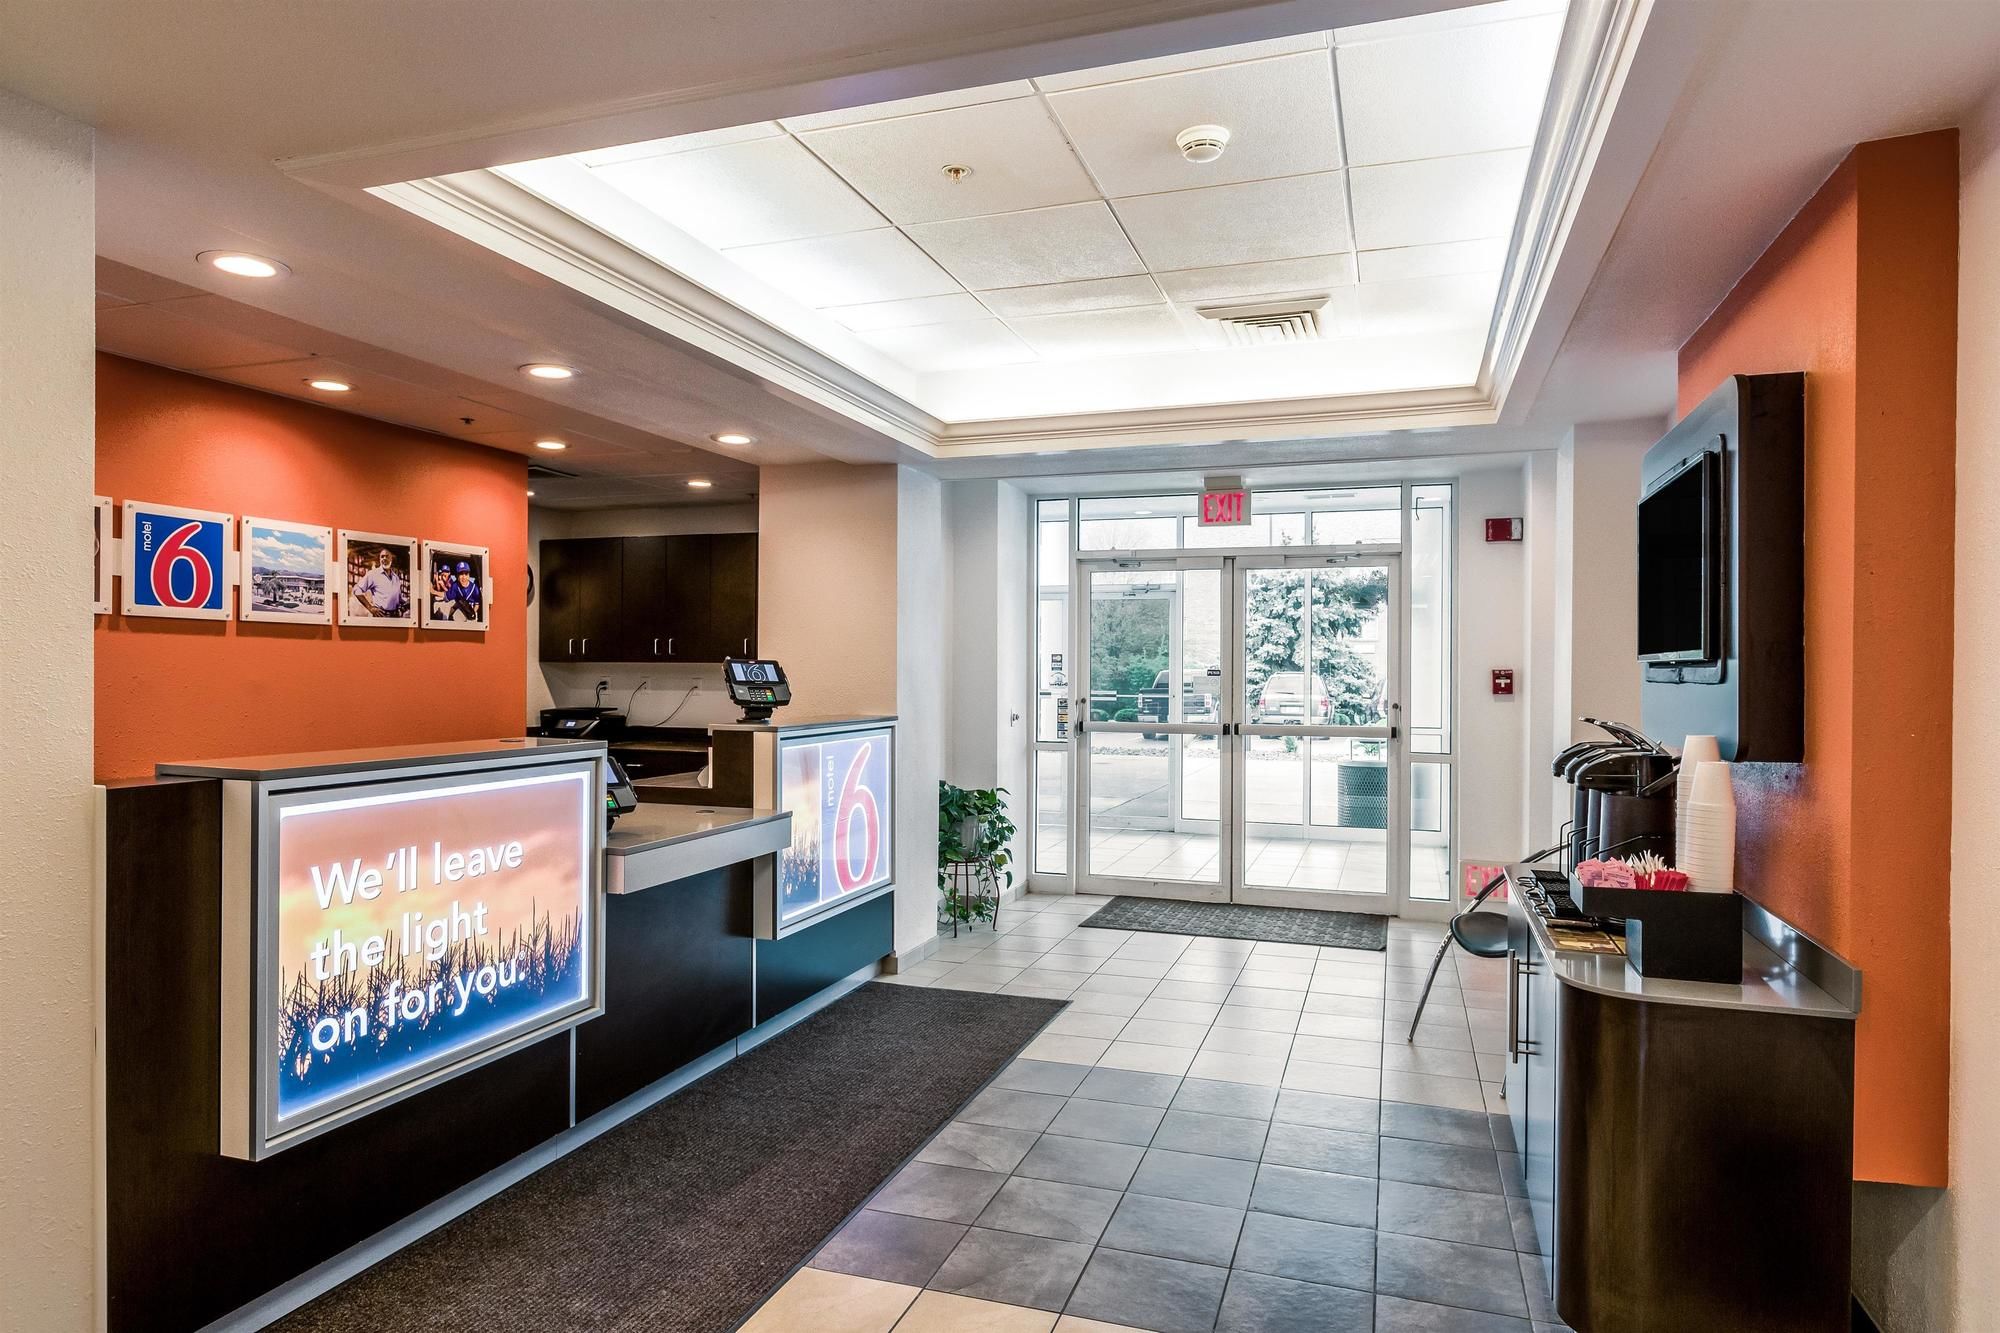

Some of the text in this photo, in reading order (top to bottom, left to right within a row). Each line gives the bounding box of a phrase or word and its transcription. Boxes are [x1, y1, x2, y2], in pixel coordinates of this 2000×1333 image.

[1203, 492, 1246, 523] EXIT
[142, 521, 214, 609] motel 6
[826, 741, 880, 894] motel 6
[310, 841, 524, 911] We'll leave
[310, 900, 488, 981] the light
[311, 1003, 369, 1052] on
[384, 979, 444, 1027] for
